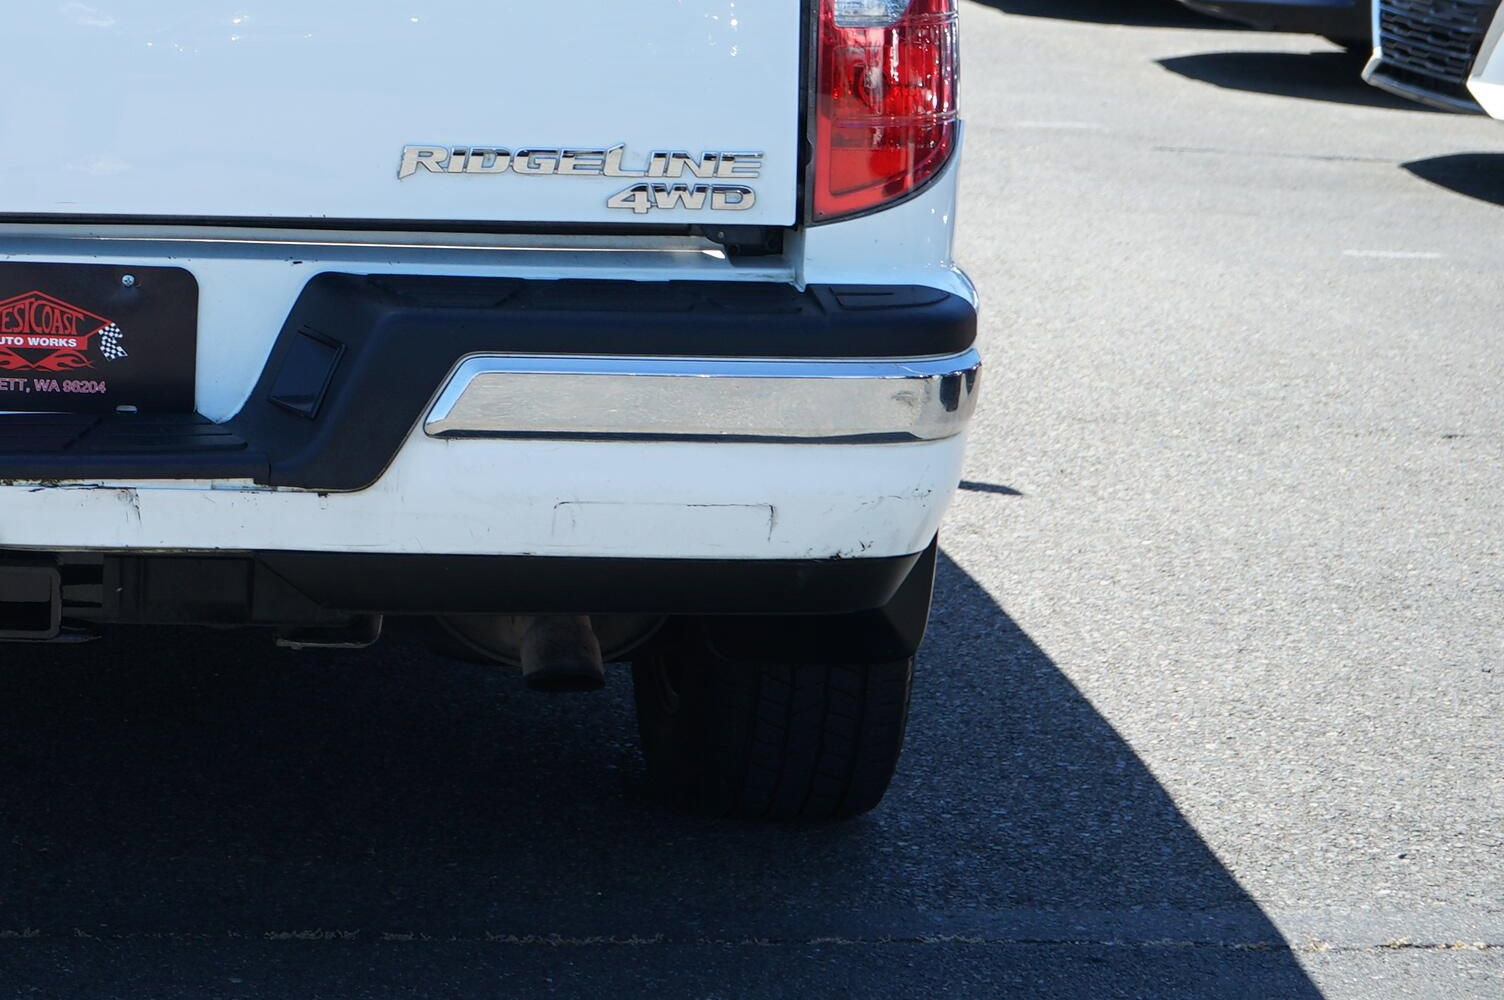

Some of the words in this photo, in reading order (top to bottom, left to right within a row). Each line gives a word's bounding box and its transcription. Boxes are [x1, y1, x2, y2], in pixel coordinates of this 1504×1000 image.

[397, 142, 765, 180] RIDGELINE
[606, 181, 757, 215] 4WD
[27, 337, 78, 348] WORKS
[33, 378, 61, 392] WA
